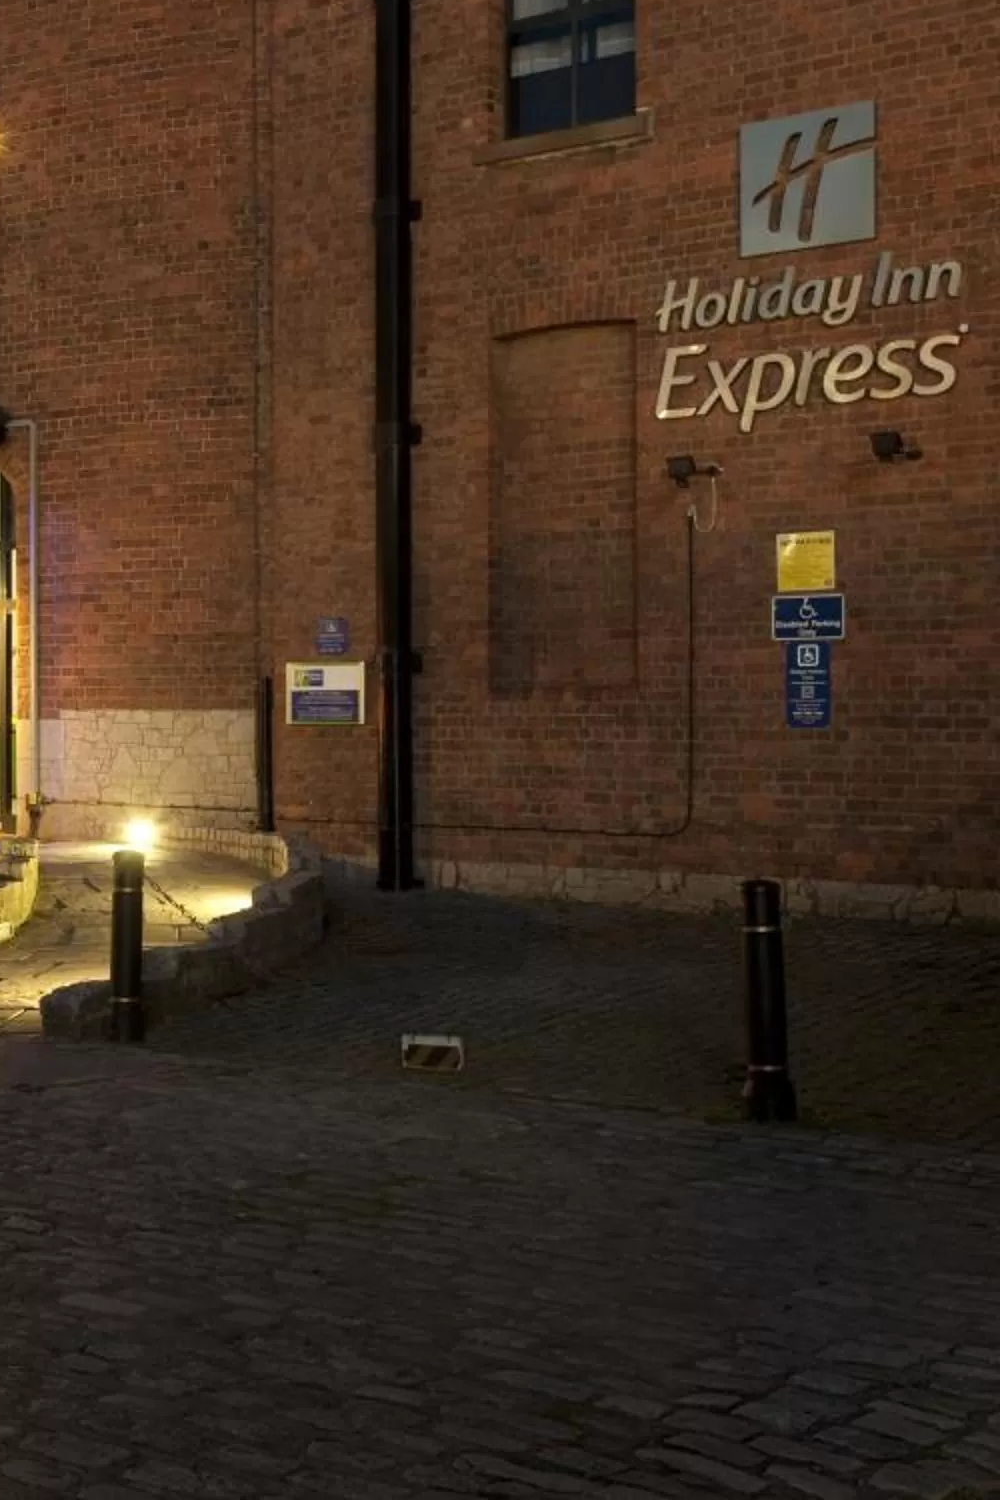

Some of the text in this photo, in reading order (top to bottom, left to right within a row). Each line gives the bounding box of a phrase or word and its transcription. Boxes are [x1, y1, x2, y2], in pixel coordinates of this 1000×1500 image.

[655, 251, 962, 334] Holiday Inn
[655, 334, 961, 433] Express
